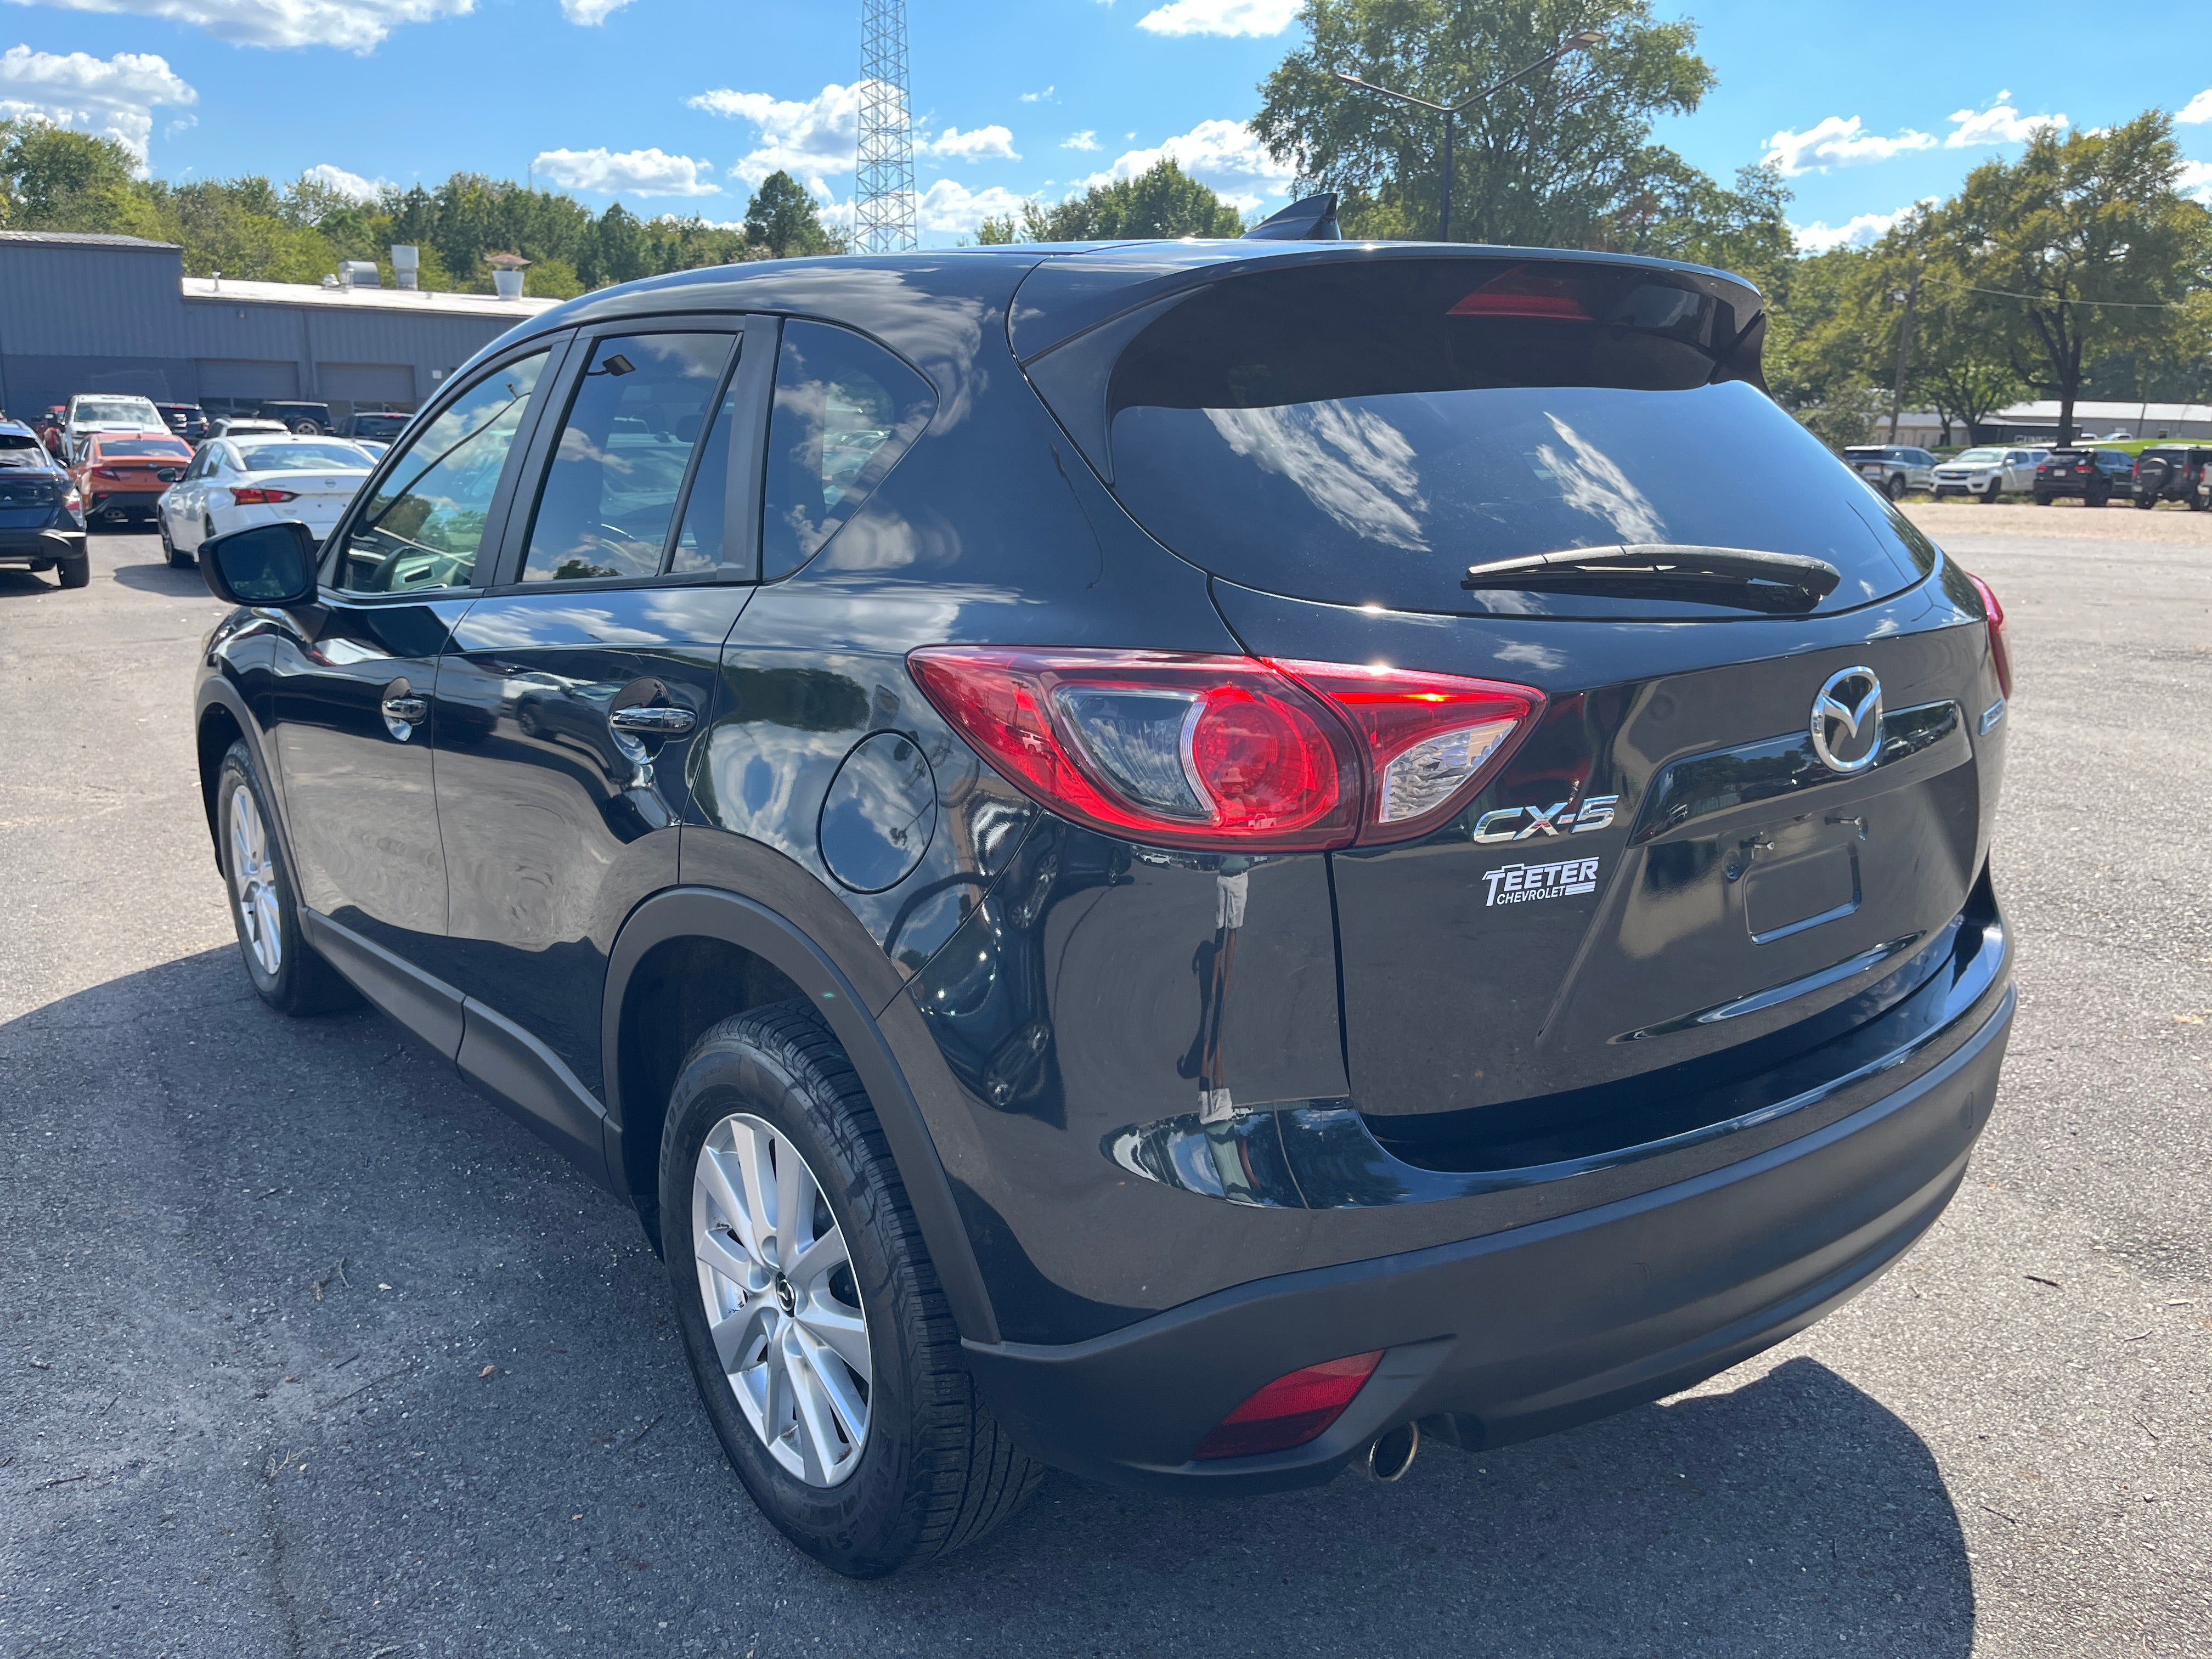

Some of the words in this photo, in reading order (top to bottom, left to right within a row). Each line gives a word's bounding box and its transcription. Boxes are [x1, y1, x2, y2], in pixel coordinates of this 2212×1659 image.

[1473, 795, 1619, 843] CX-5
[1482, 857, 1599, 906] TEETER
[1497, 887, 1565, 905] CHEVROLET
